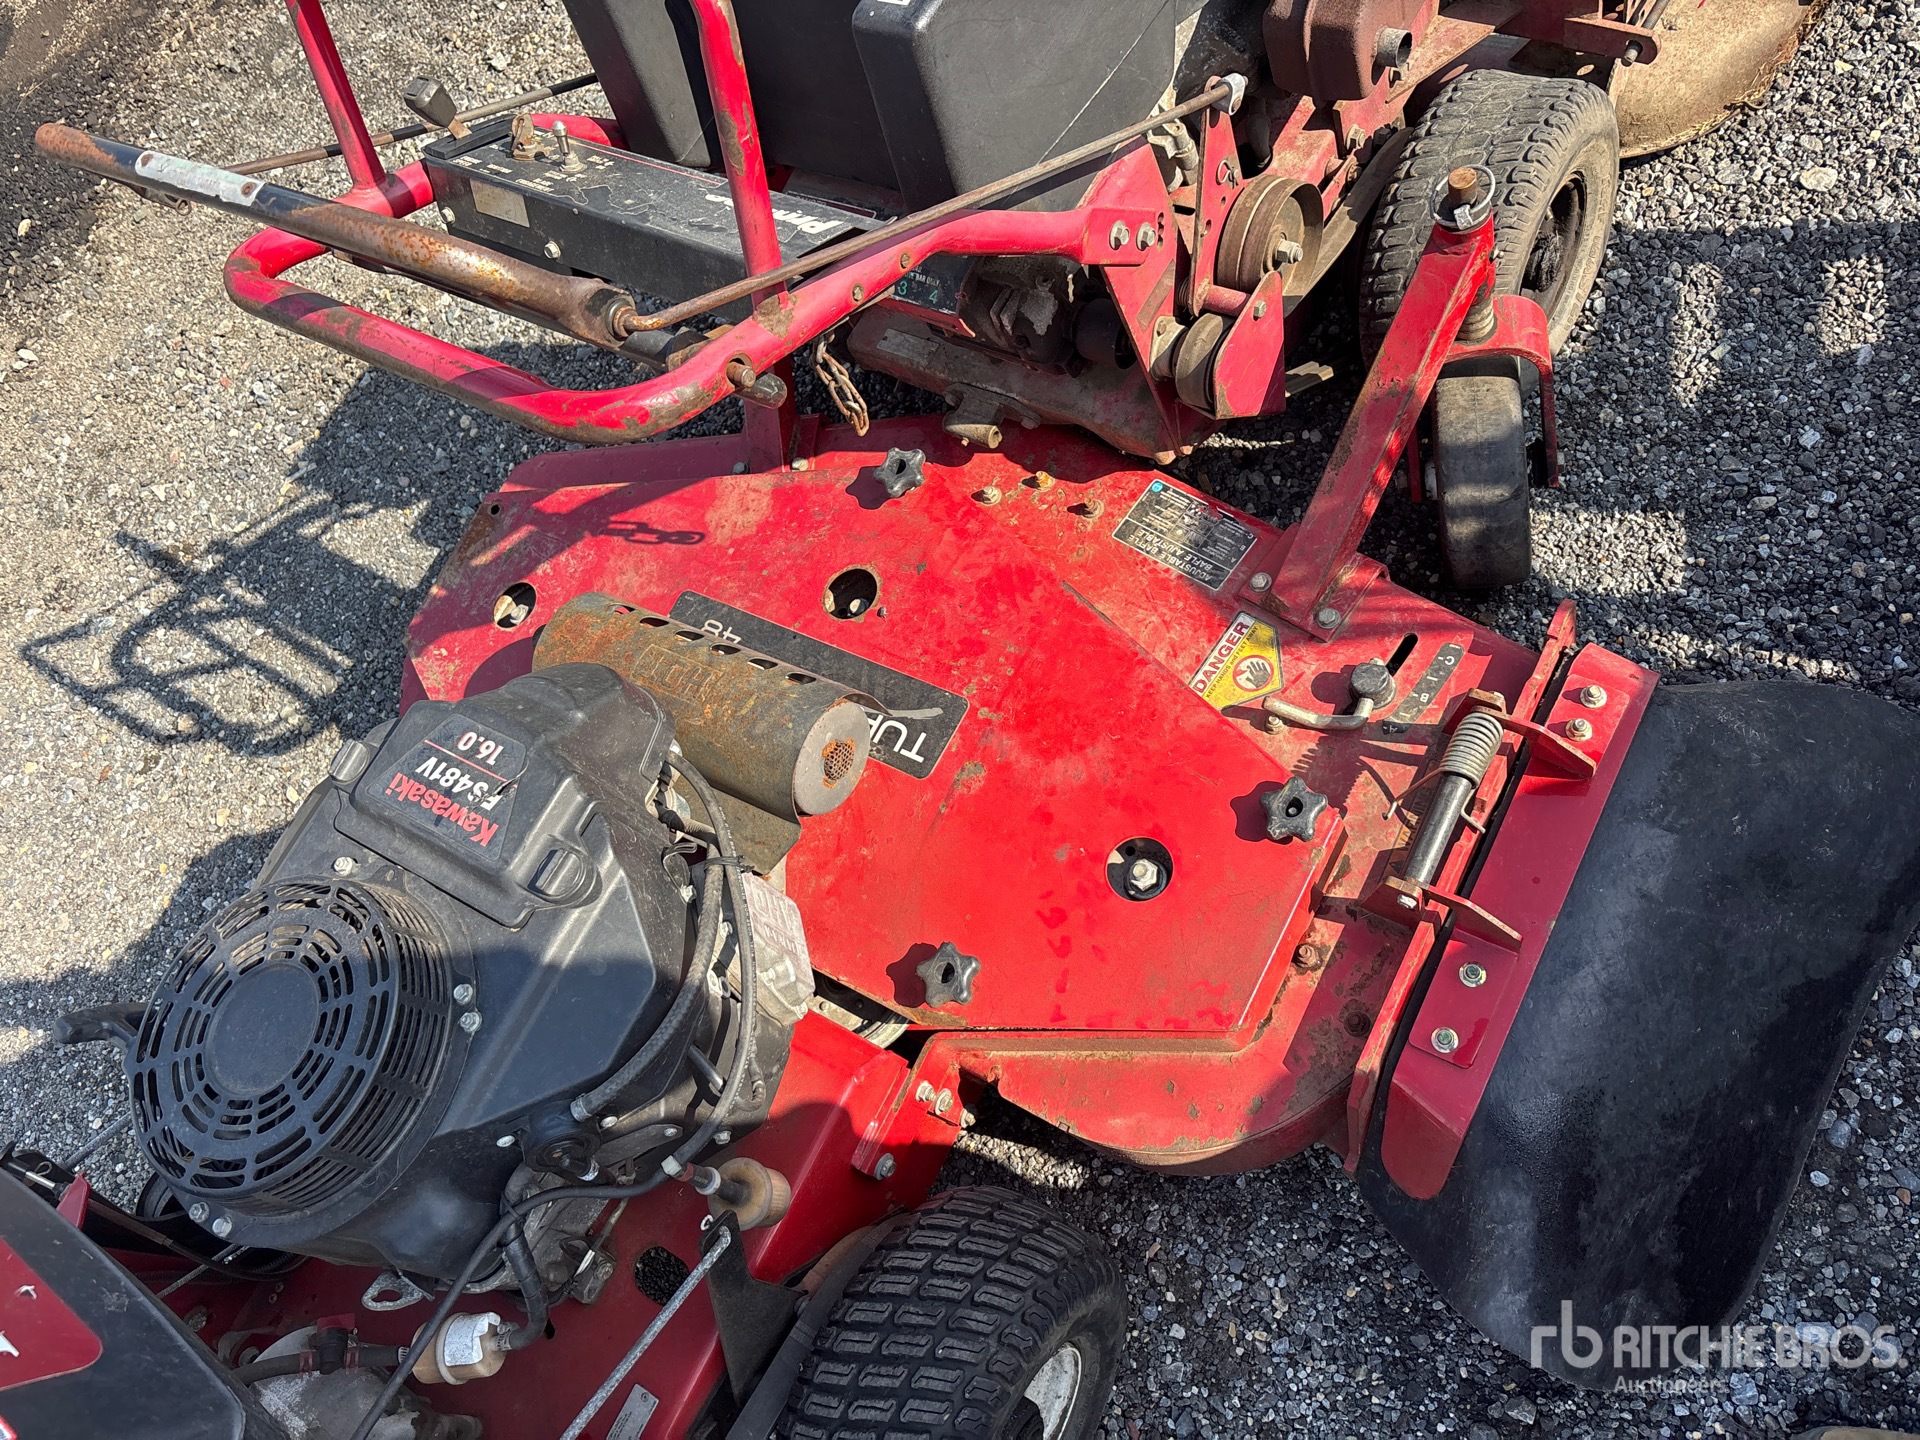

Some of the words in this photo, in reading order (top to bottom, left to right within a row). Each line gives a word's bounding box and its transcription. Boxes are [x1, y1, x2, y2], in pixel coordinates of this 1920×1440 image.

[897, 280, 908, 296] 3
[928, 289, 939, 304] 4
[1128, 533, 1158, 554] BAFFLE
[1138, 528, 1184, 556] AJUSTABLE
[1159, 551, 1213, 582] ADJUSTABLE
[1183, 553, 1214, 571] BAFLE
[1192, 621, 1250, 694] DANGER
[1206, 682, 1218, 699] KEEP
[1215, 665, 1231, 684] HANDS
[1236, 640, 1248, 657] FEET
[1246, 626, 1259, 642] AWAY
[1444, 655, 1455, 666] C
[1419, 692, 1430, 703] B
[457, 731, 504, 766] 16.0
[415, 756, 503, 811] FS481V
[385, 772, 500, 848] Kawasaki
